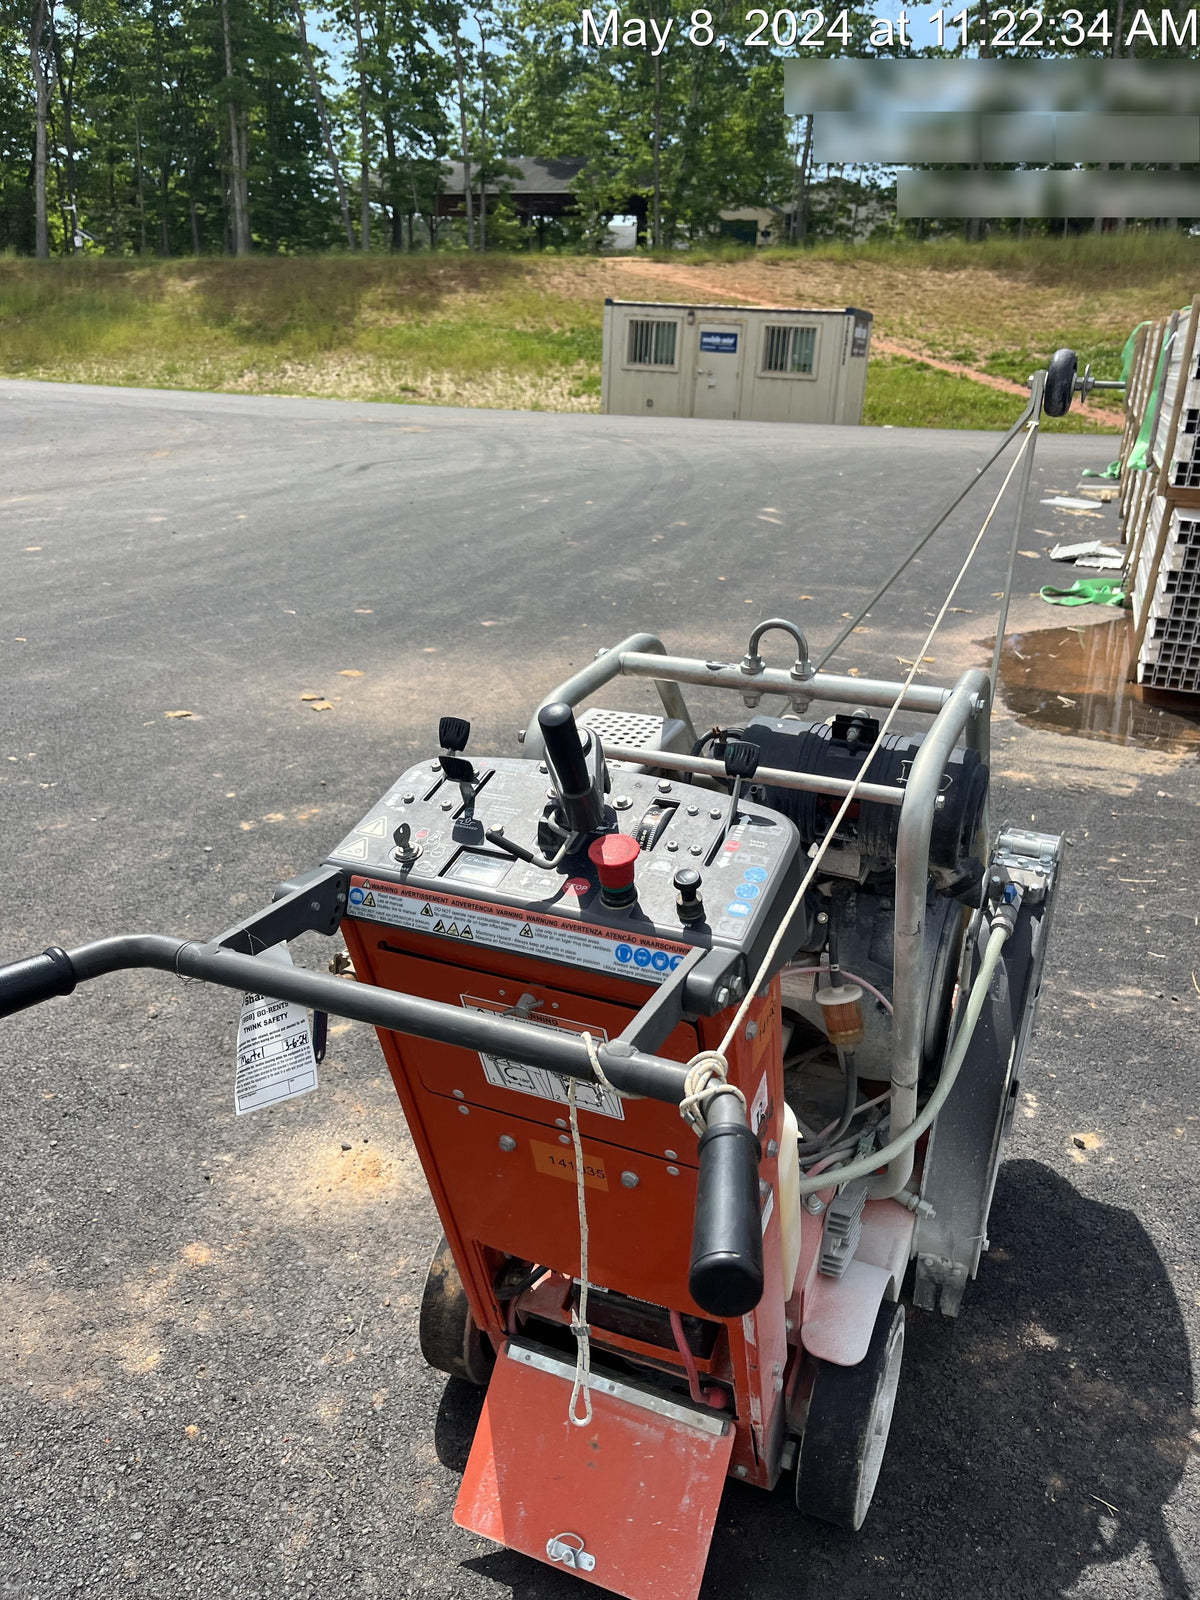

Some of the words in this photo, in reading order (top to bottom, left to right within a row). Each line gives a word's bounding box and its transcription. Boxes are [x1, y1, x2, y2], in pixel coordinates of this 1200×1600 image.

[565, 882, 589, 891] STOP
[371, 884, 398, 894] WARNING
[401, 891, 449, 904] AVERTISSEMENT
[451, 900, 493, 913] ADVERTENCIA
[496, 909, 524, 920] VARNING
[526, 915, 559, 927] WARNUNG
[561, 923, 602, 936] AVVERTENZA
[243, 1021, 262, 1034] THINK
[263, 1012, 288, 1026] SAFETY
[548, 1155, 606, 1179] 14135
